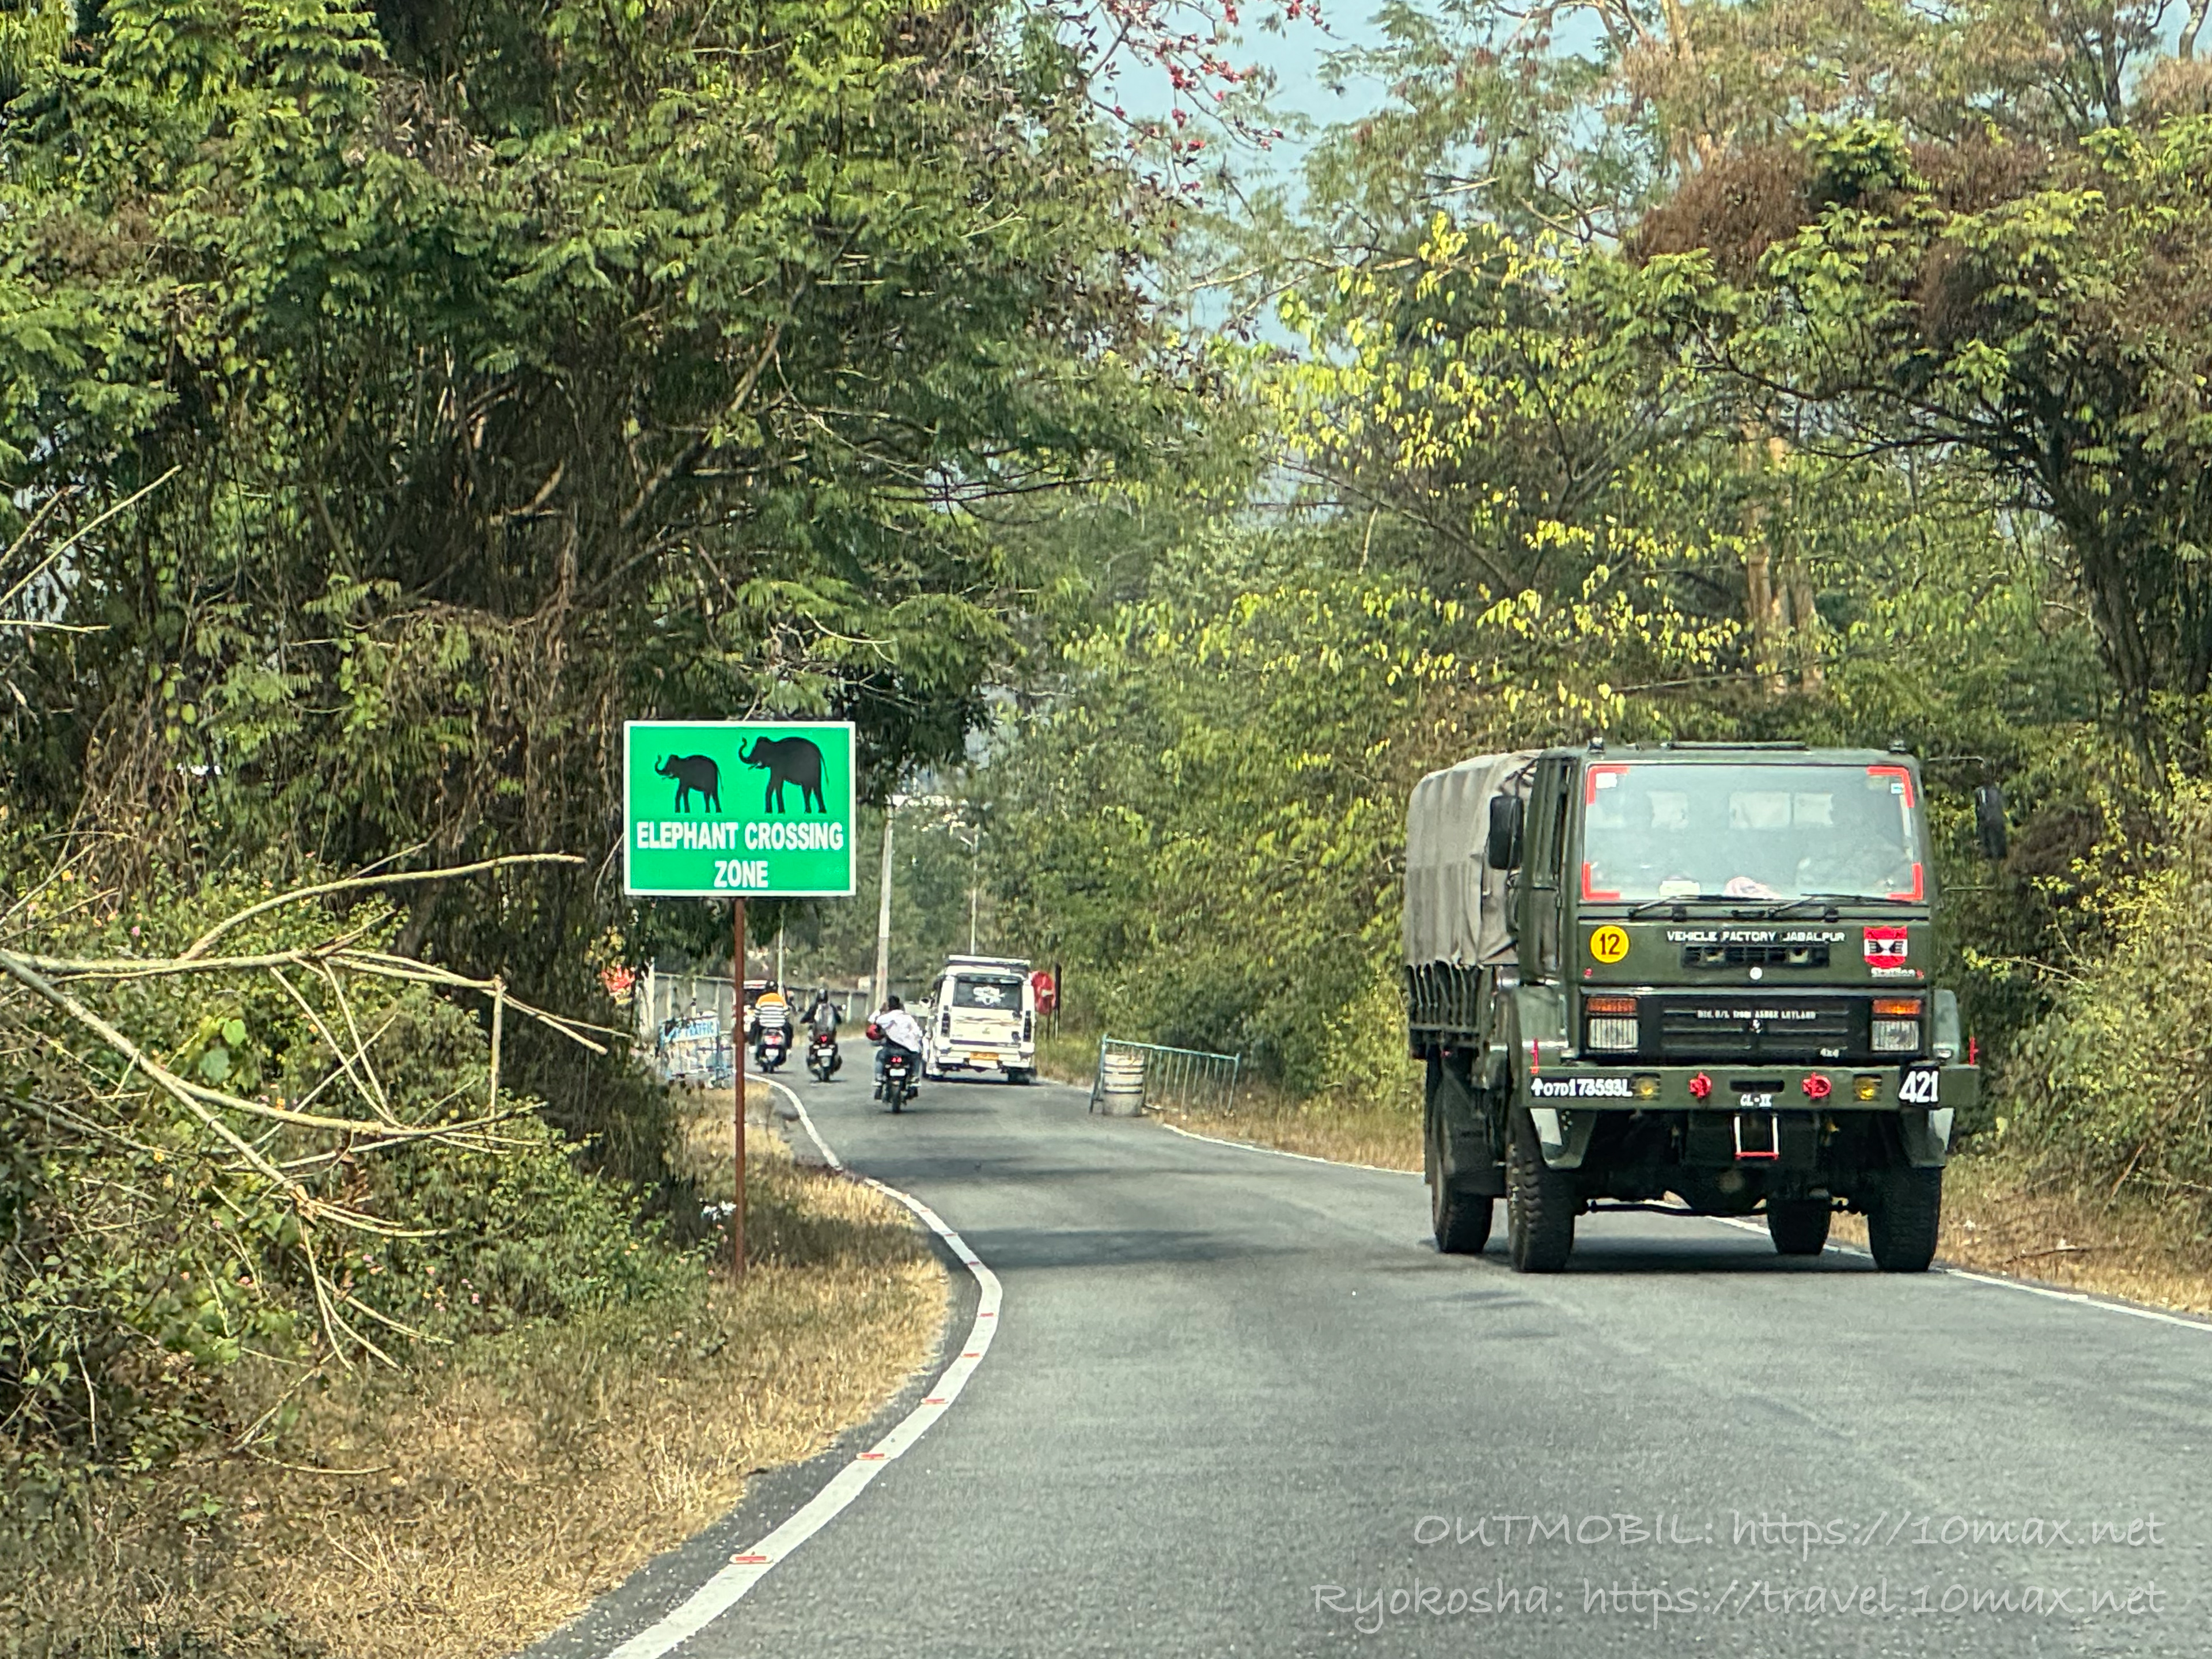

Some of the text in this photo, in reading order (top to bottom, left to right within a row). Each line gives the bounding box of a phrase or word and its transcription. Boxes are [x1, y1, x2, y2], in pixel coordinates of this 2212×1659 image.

[636, 821, 844, 850] ELEPHANT CROSSING
[713, 859, 769, 888] ZONE
[1599, 933, 1620, 955] 12
[1666, 931, 1846, 942] VEHICLE FACTORY JABALPUR
[1899, 1070, 1939, 1103] 421
